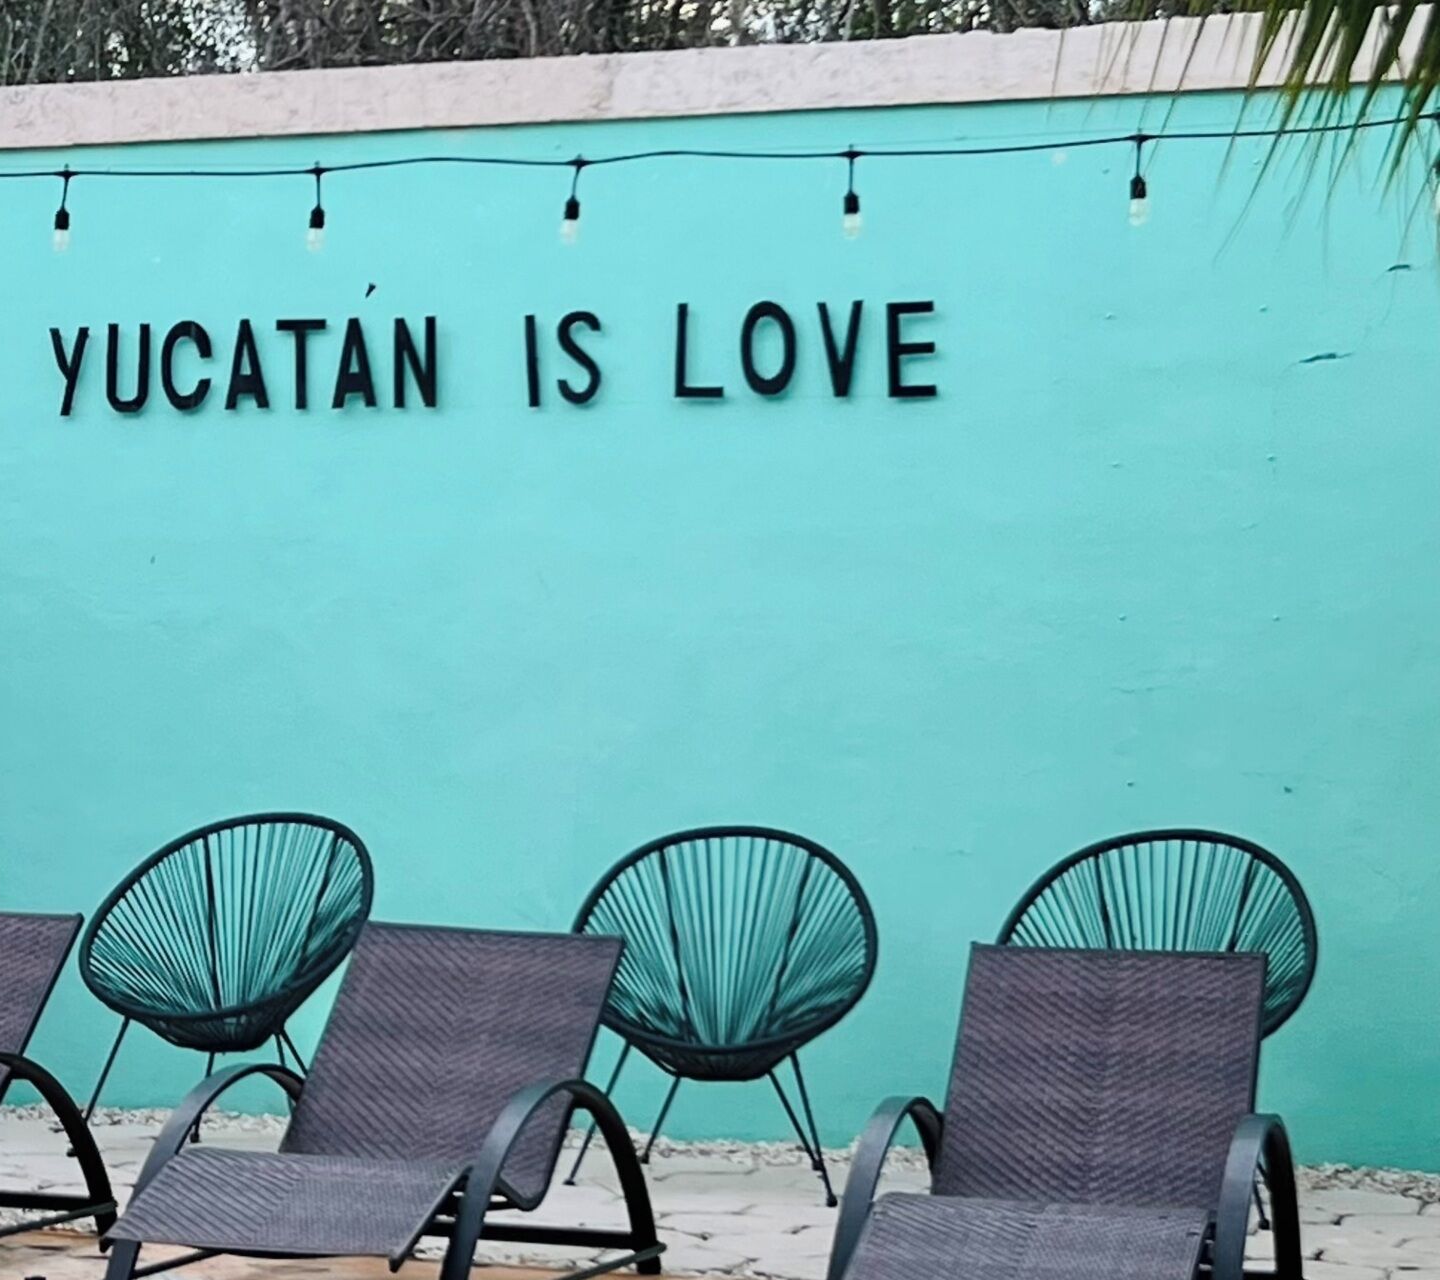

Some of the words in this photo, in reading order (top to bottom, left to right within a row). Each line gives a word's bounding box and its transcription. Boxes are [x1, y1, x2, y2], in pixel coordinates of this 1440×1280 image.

[49, 283, 438, 417] YUCATÁN
[524, 310, 603, 408] IS
[674, 299, 939, 400] LOVE
